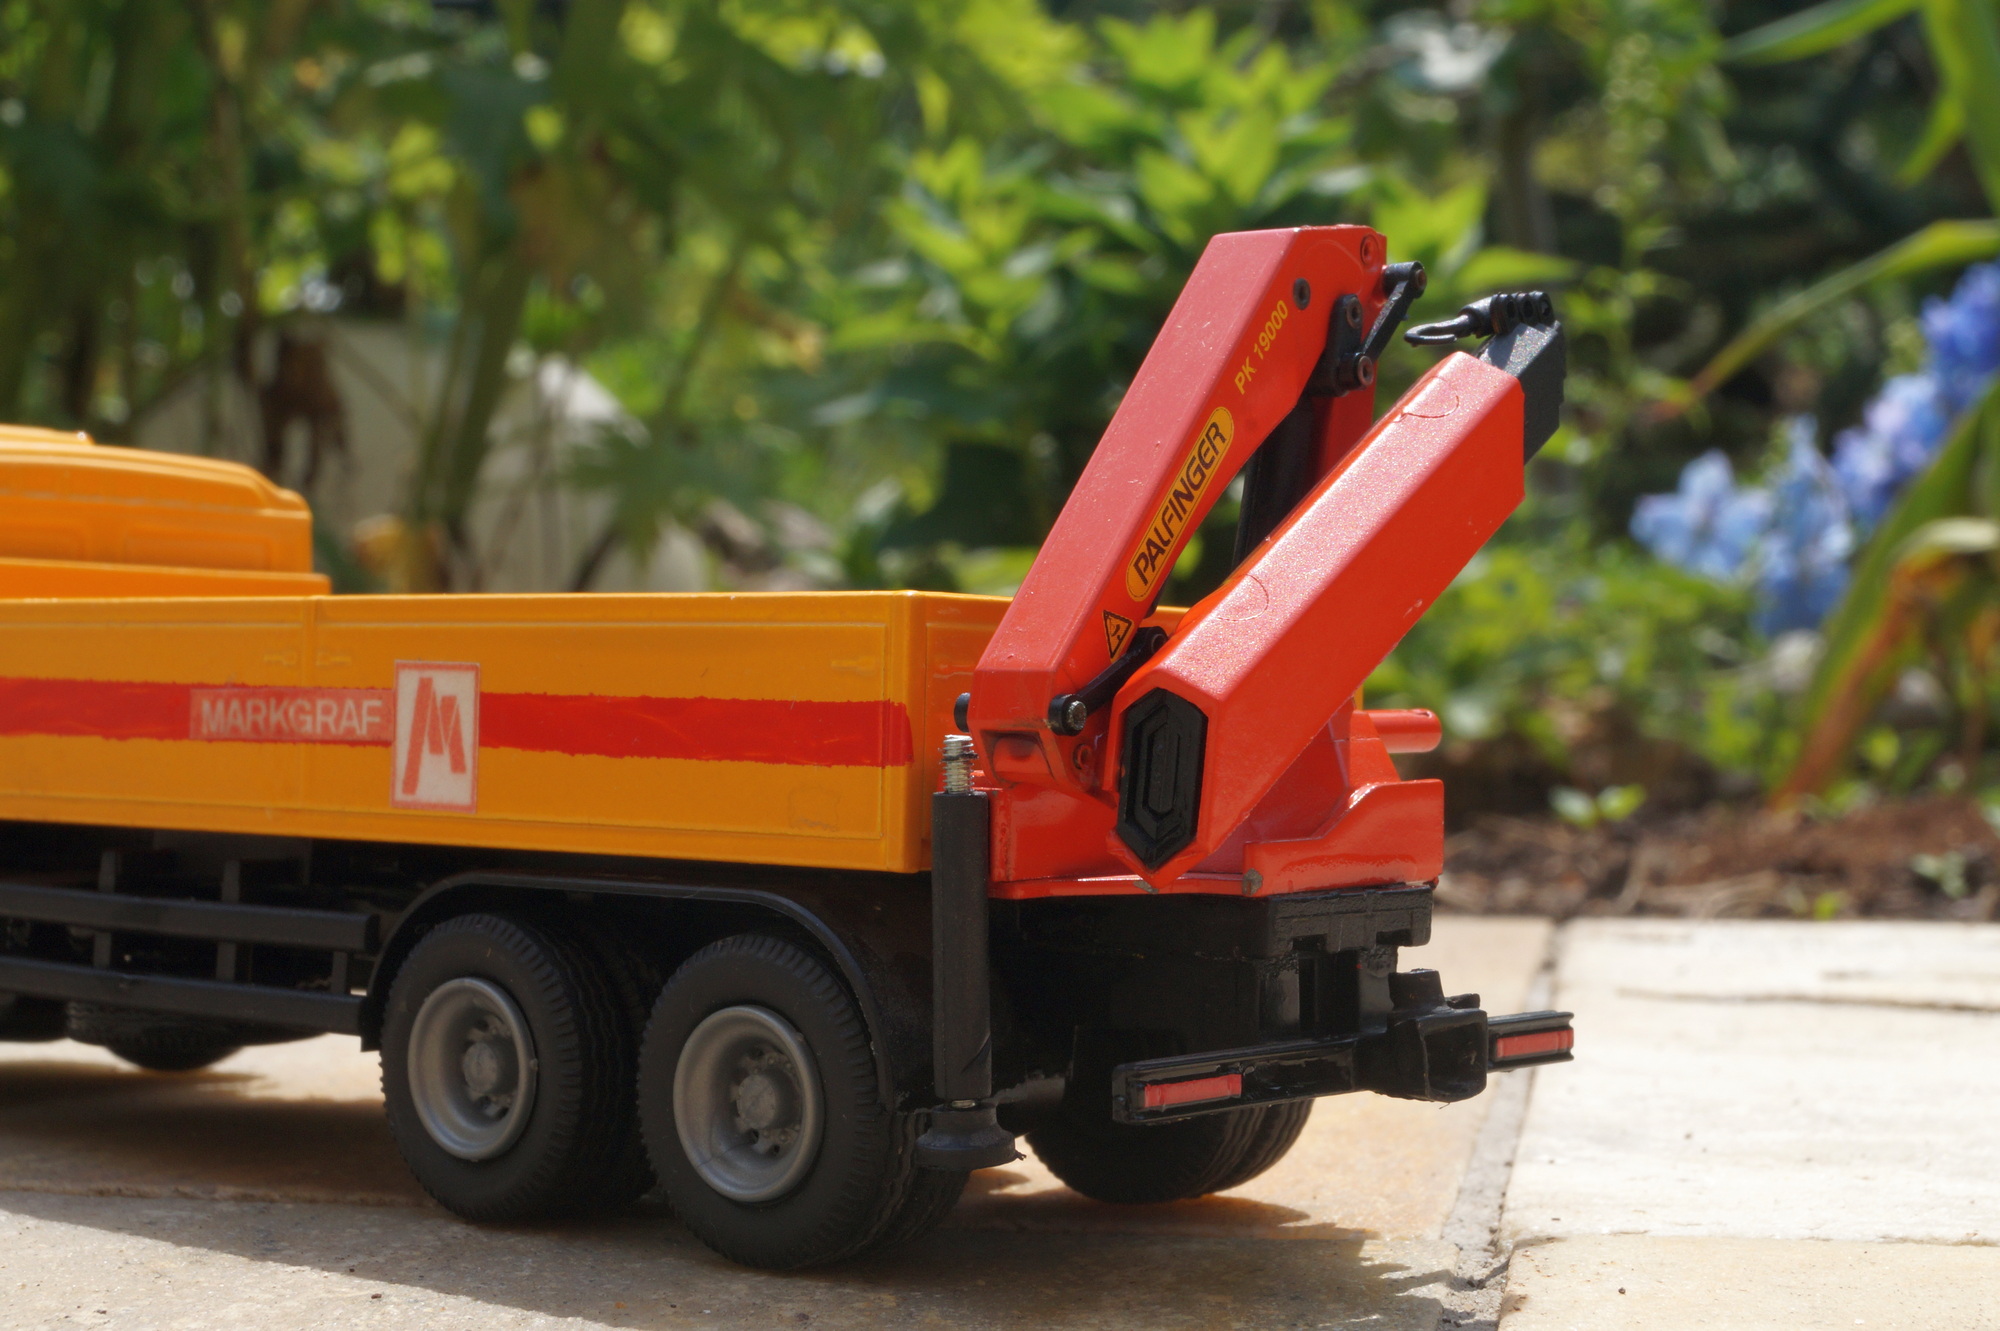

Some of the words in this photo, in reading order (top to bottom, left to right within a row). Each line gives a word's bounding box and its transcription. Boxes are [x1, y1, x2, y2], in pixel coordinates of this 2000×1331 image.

[1234, 357, 1257, 395] PK
[1253, 300, 1289, 359] 19000
[1132, 421, 1228, 587] PALFINGER
[201, 698, 383, 736] MARKGRAF
